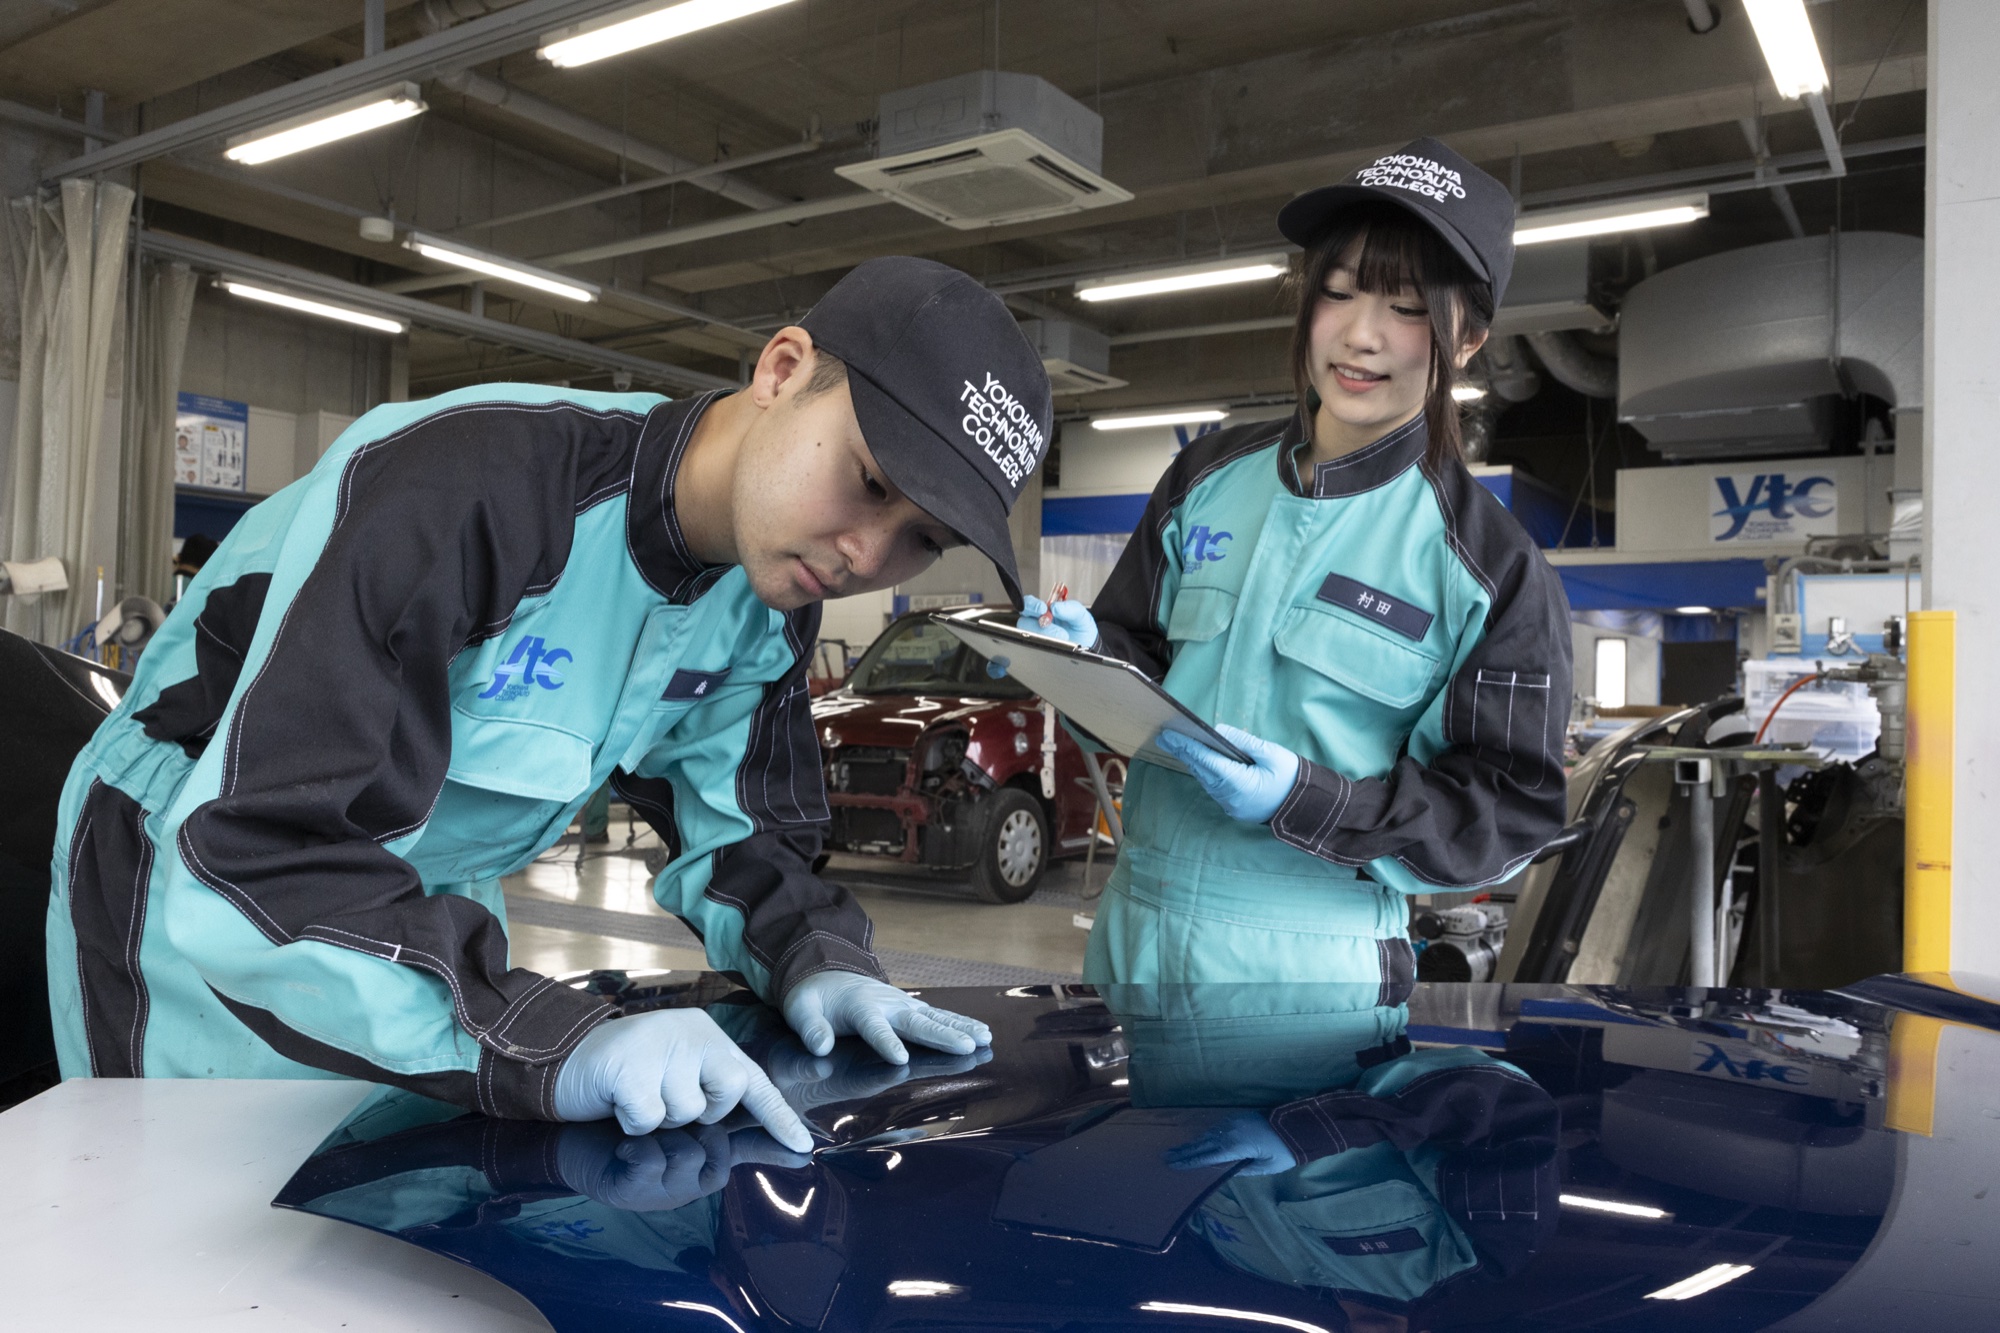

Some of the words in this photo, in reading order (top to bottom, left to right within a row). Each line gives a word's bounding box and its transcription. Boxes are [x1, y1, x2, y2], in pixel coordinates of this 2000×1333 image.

[1356, 165, 1466, 199] TECHNOAUTO
[1360, 175, 1448, 203] COLLEGE
[1373, 154, 1462, 186] YOKOHAMA
[960, 379, 1036, 475] TECHNOAUTO
[982, 371, 1043, 456] YOKOHAMA
[962, 414, 1023, 488] COLLEGE
[1713, 473, 1835, 542] ytc
[1357, 591, 1392, 616] 村田
